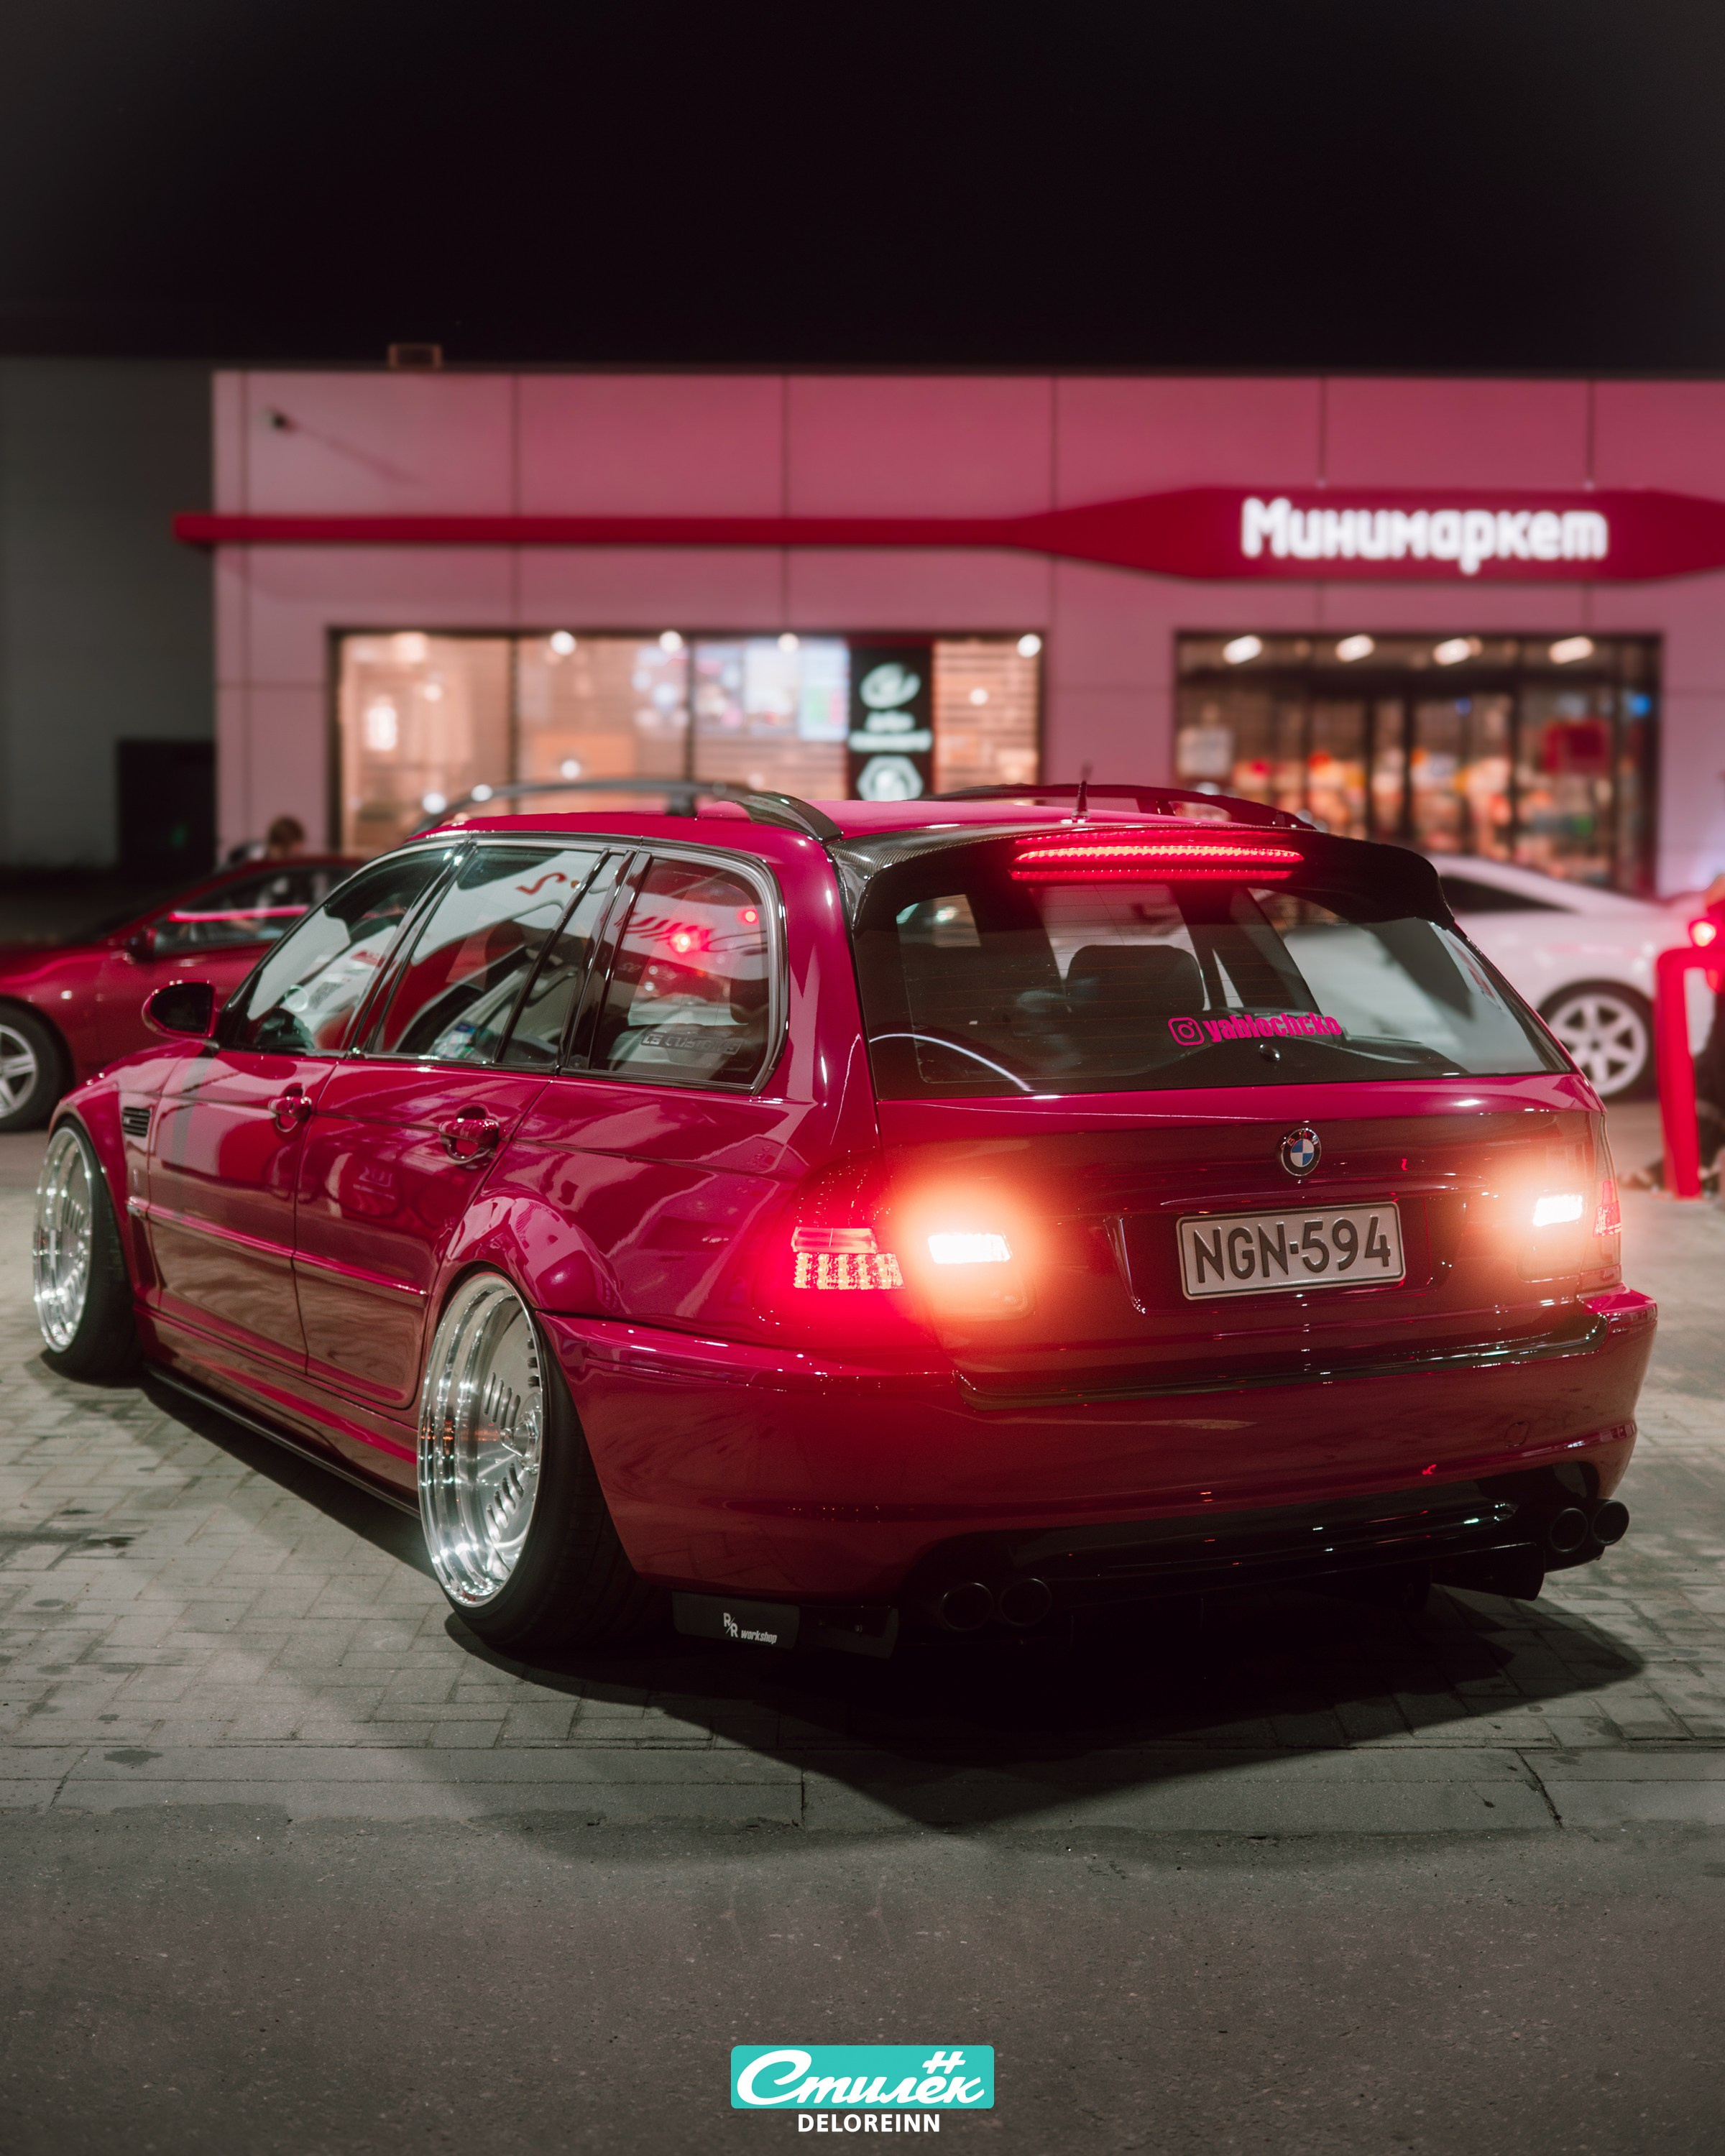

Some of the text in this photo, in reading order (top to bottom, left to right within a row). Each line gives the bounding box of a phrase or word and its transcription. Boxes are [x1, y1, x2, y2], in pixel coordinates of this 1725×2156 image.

[1242, 497, 1608, 575] Минимаркет
[1202, 1012, 1342, 1042] yablochcko
[1193, 1215, 1391, 1284] NGN-594
[740, 1629, 778, 1645] workshop
